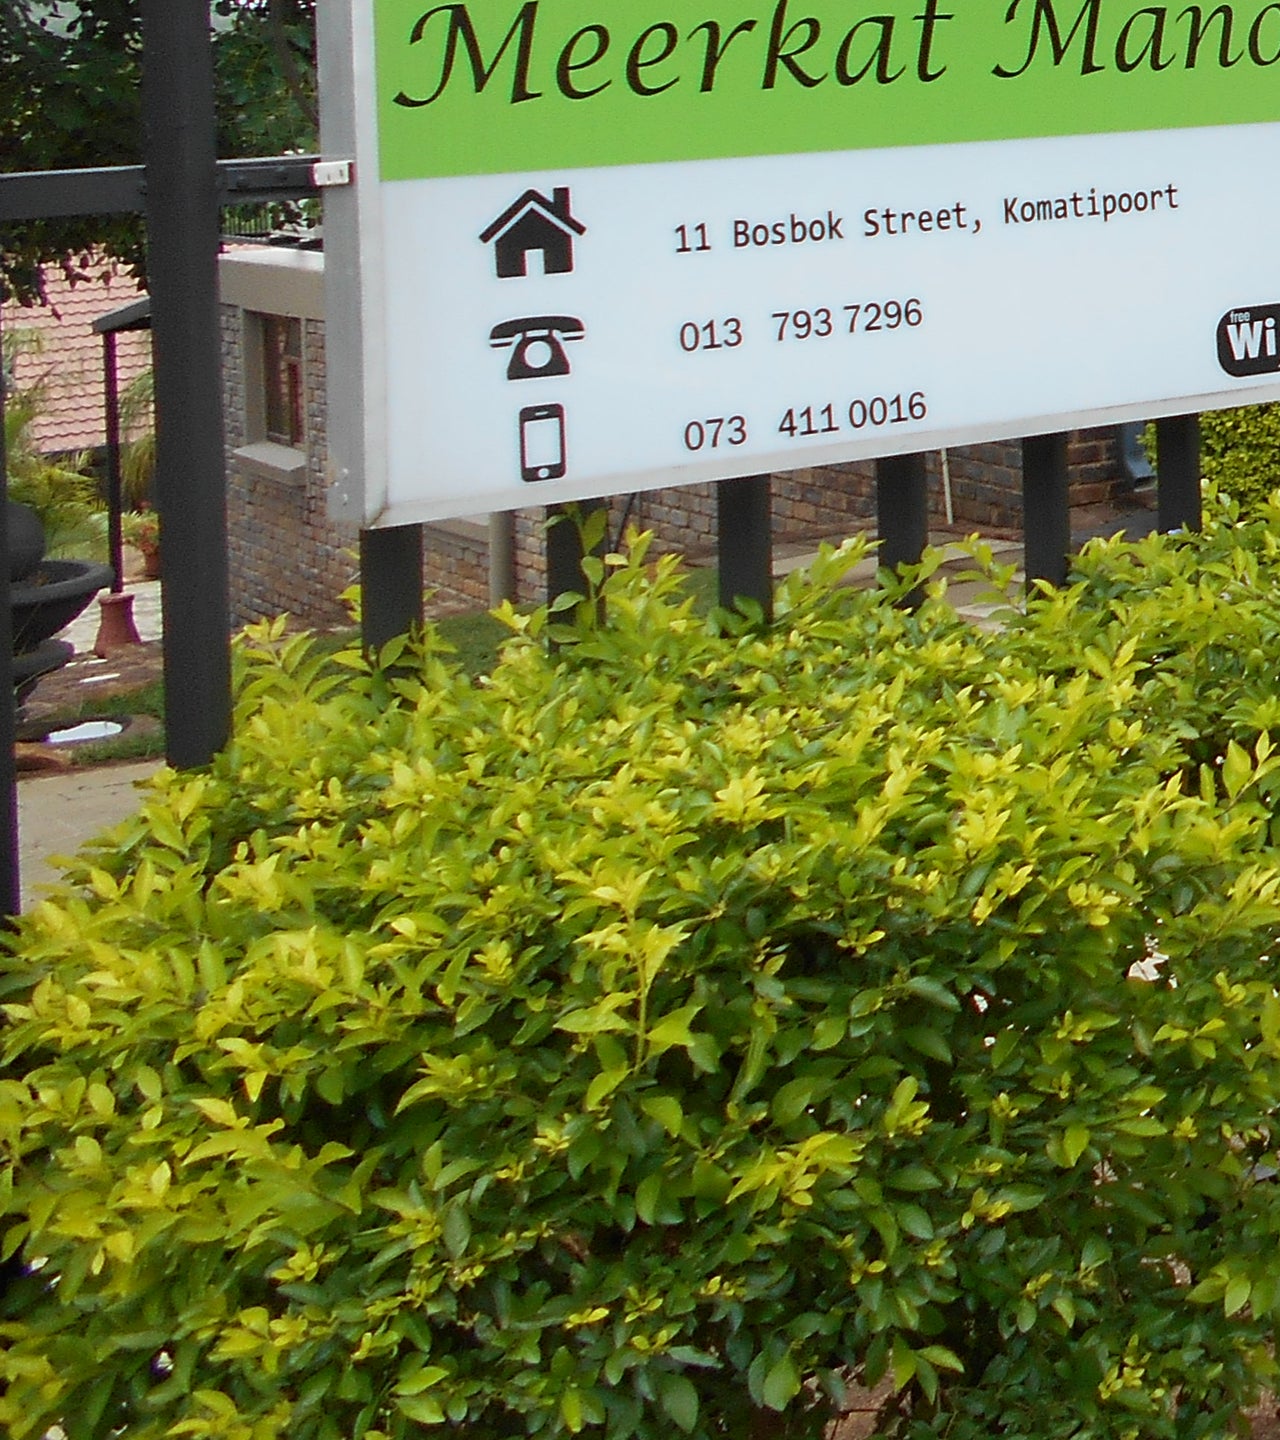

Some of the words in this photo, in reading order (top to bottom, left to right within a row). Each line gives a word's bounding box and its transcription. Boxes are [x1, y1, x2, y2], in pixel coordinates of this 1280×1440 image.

[674, 222, 712, 253] 11
[733, 210, 844, 248] Bosbok
[863, 202, 981, 237] Street,
[1003, 183, 1179, 224] Komatipoort
[679, 317, 743, 352] 013
[771, 307, 833, 342] 793
[843, 298, 923, 334] 7296
[1230, 310, 1251, 323] free
[684, 415, 747, 451] 073
[778, 403, 840, 438] 411
[848, 391, 927, 429] 0016
